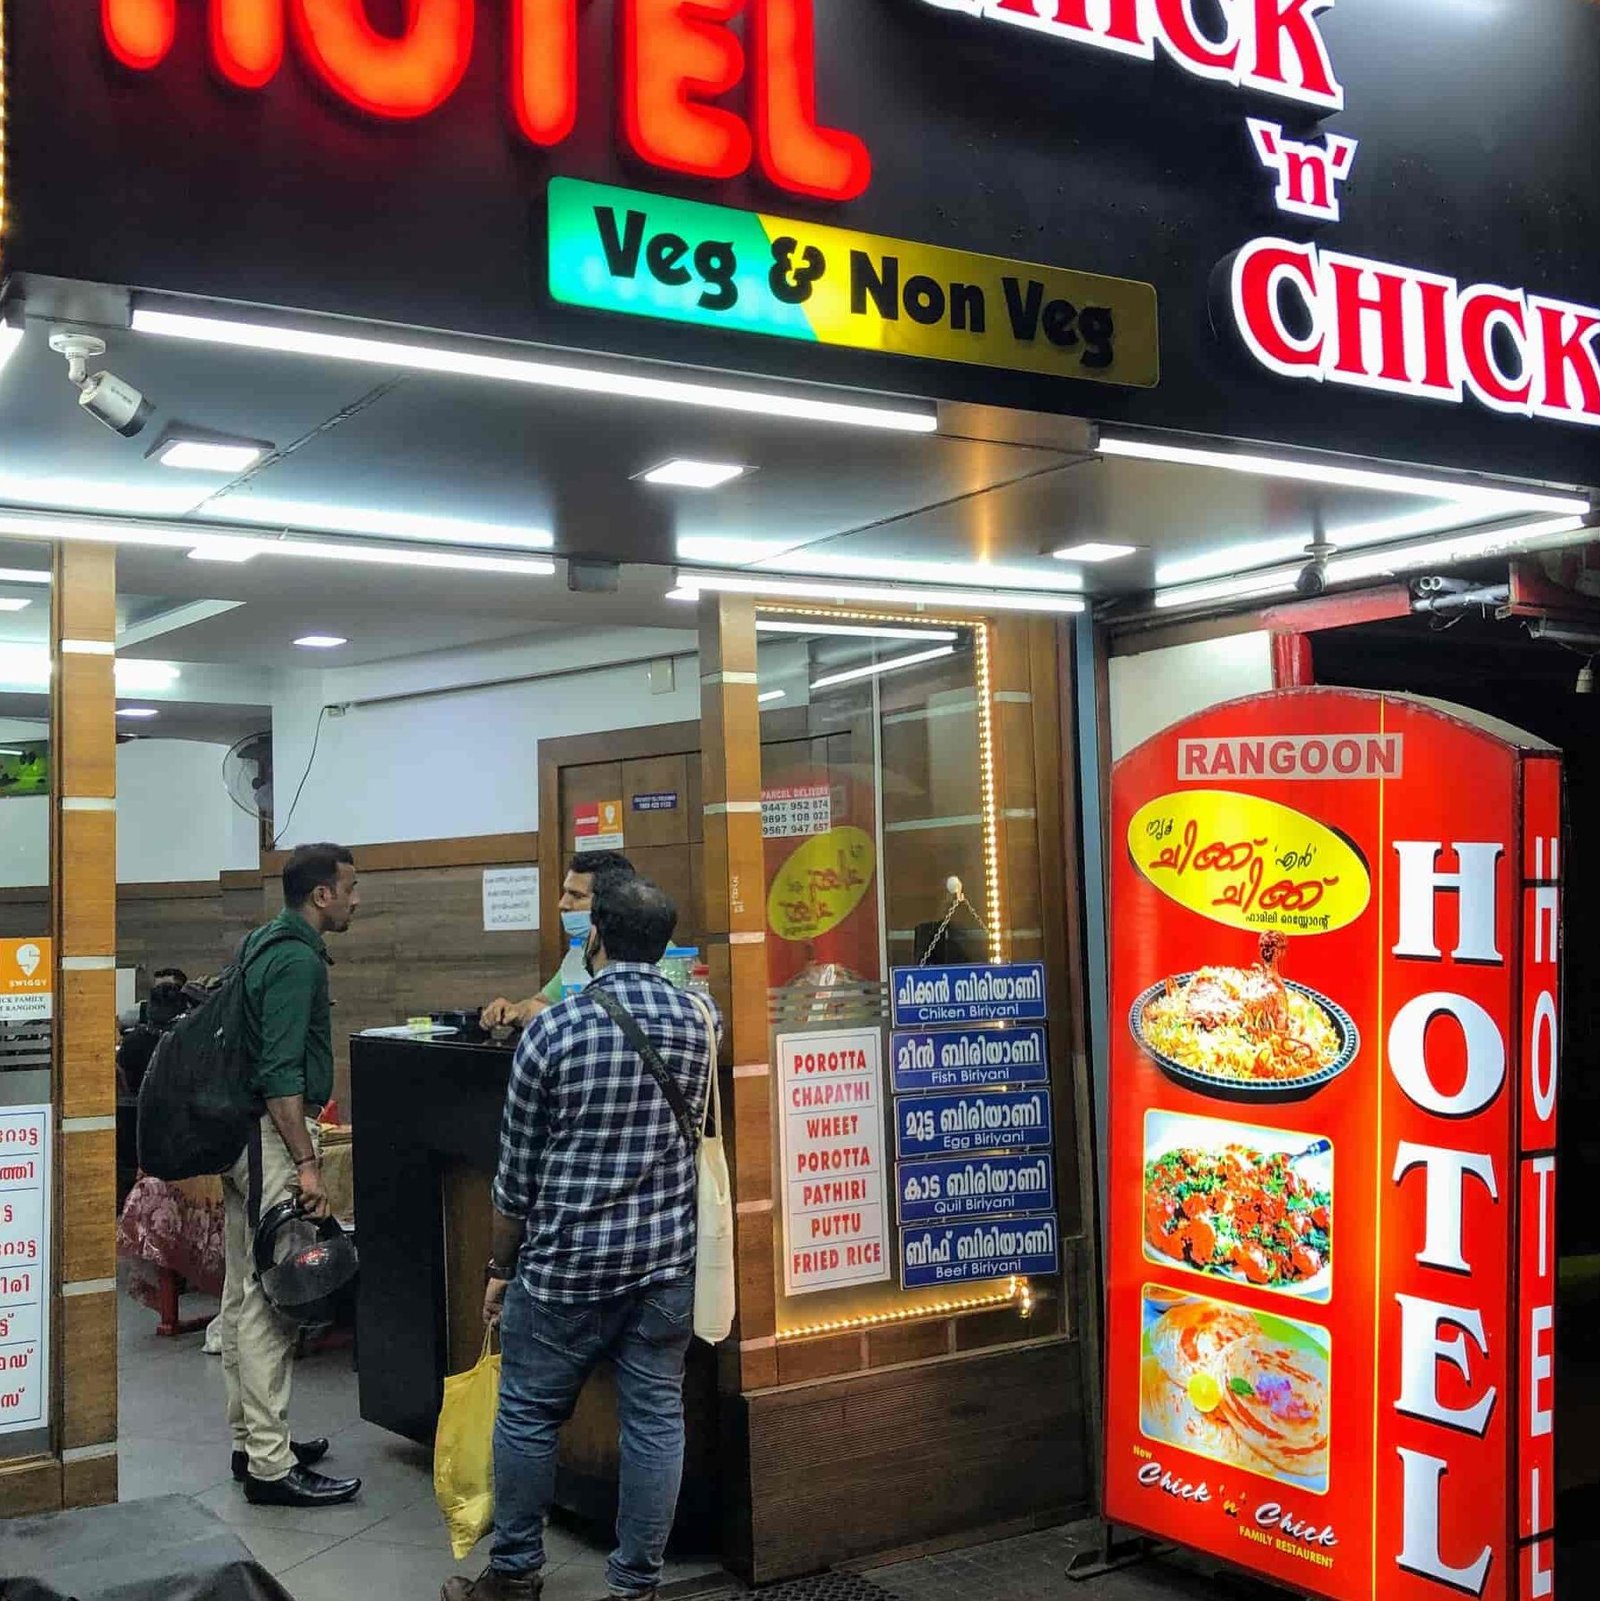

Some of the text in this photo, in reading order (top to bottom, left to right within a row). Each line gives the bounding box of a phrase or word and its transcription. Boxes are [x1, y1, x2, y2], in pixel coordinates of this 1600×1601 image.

[593, 205, 1115, 369] Veg & Non Veg
[1231, 237, 1600, 426] CHICK
[1184, 739, 1396, 774] RANGOON
[954, 969, 1041, 1003] ബിരിയാണി
[918, 1004, 1020, 1021] Chiken Biriyani
[793, 1049, 867, 1074] POROTTA
[941, 1033, 1040, 1068] ബിരിയാണി
[931, 1068, 1010, 1084] Fish Biriyani
[792, 1081, 870, 1107] CHAPATHI
[806, 1114, 859, 1139] WHEET
[940, 1096, 1042, 1132] ബിരിയാണി
[943, 1131, 1025, 1149] Egg Biriyani
[797, 1146, 871, 1173] POROTTA
[803, 1179, 867, 1206] PATHIRI
[946, 1160, 1047, 1197] ബിരിയാണി
[934, 1196, 1016, 1214] Quil Biriyani
[1386, 840, 1507, 1594] HOTEL
[1530, 835, 1559, 1599] HOTEL
[811, 1212, 862, 1239] PUTTU
[957, 1223, 1054, 1260] ബിരിയാണി
[793, 1242, 881, 1275] FRIED RICE
[936, 1260, 1022, 1279] Beef Biriyani
[1133, 1445, 1153, 1460] New
[1138, 1461, 1212, 1502] Chick
[1255, 1502, 1339, 1546] Chick
[1239, 1525, 1335, 1570] FAMILY RESTAURENT
